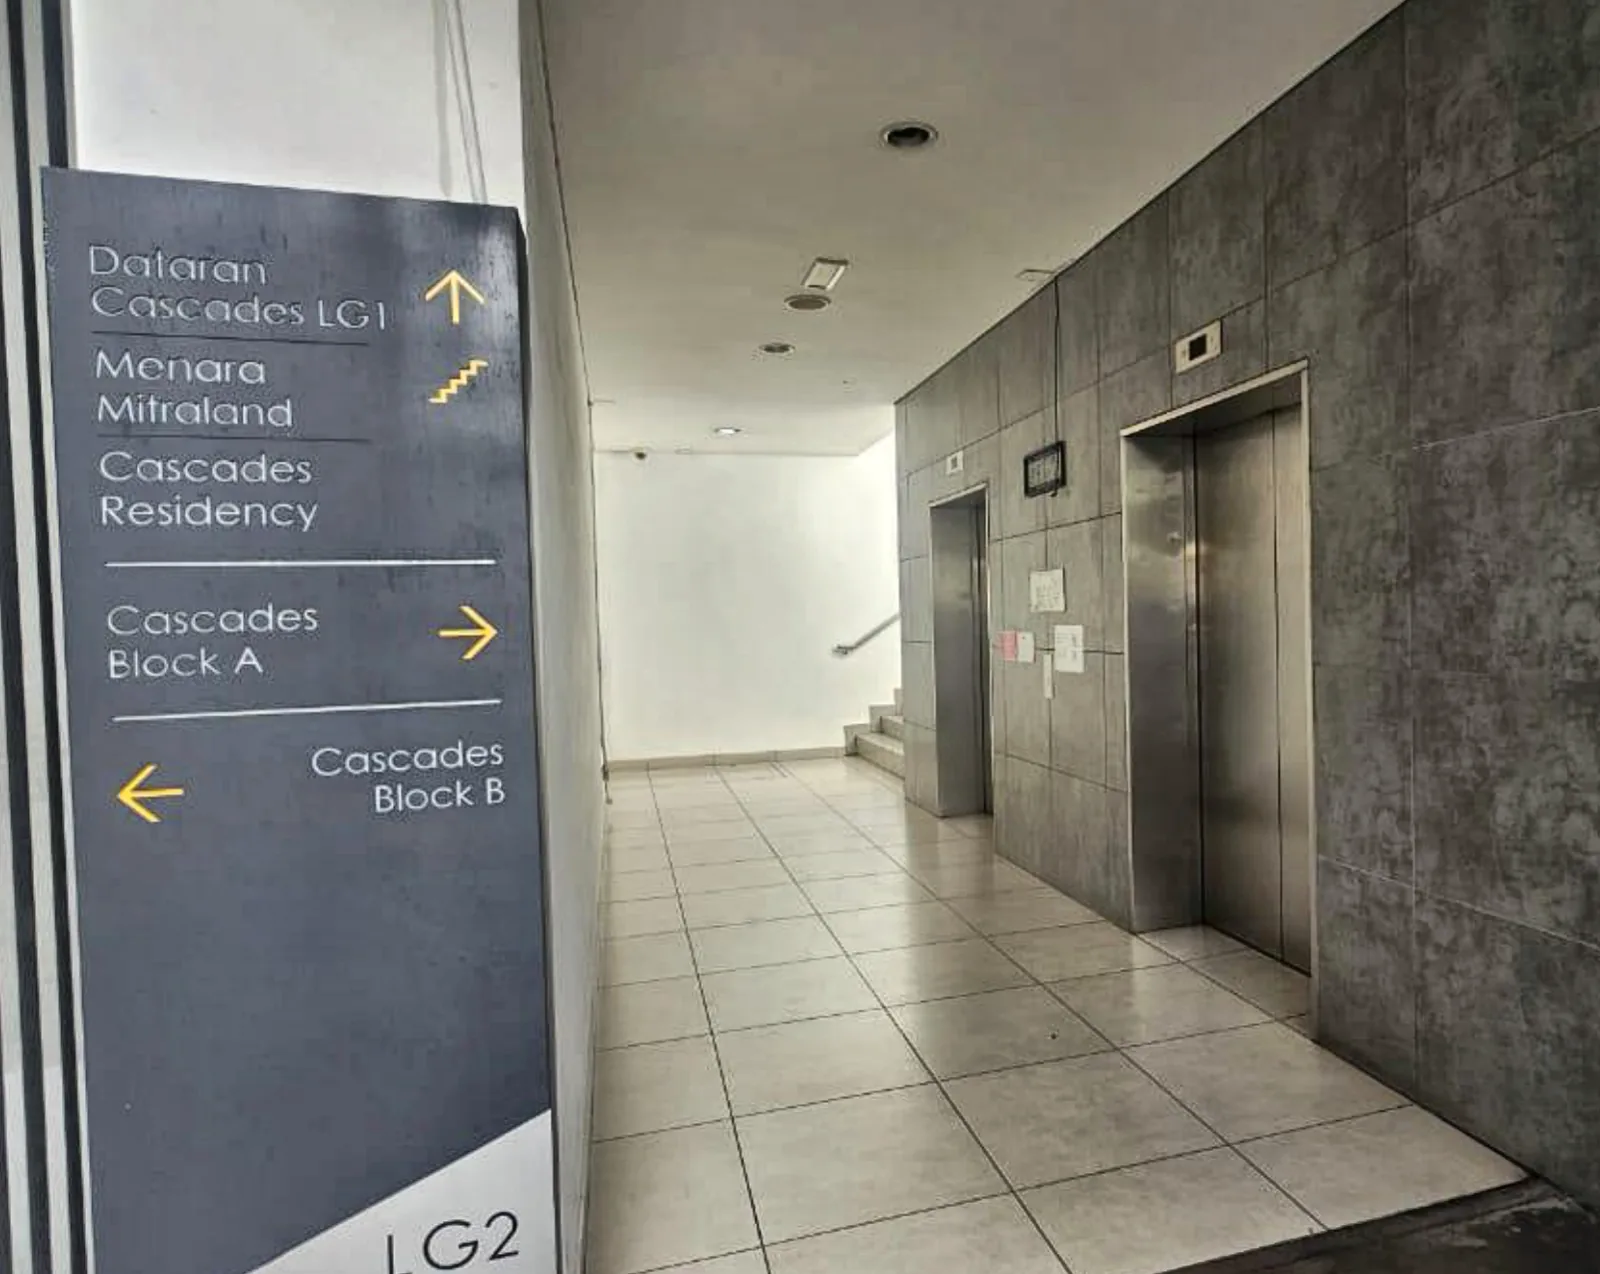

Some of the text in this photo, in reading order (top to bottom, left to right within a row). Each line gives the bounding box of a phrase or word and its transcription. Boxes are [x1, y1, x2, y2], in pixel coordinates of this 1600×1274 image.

[88, 246, 267, 285] Dataran
[91, 286, 386, 331] Cascades LG1
[95, 349, 266, 385] Menara
[97, 394, 294, 429] Mitraland
[99, 450, 312, 485] Cascades
[100, 495, 319, 532] Residency
[106, 603, 319, 636] Cascades
[108, 646, 264, 680] Block A
[311, 739, 504, 777] Cascades
[374, 778, 506, 814] Block B
